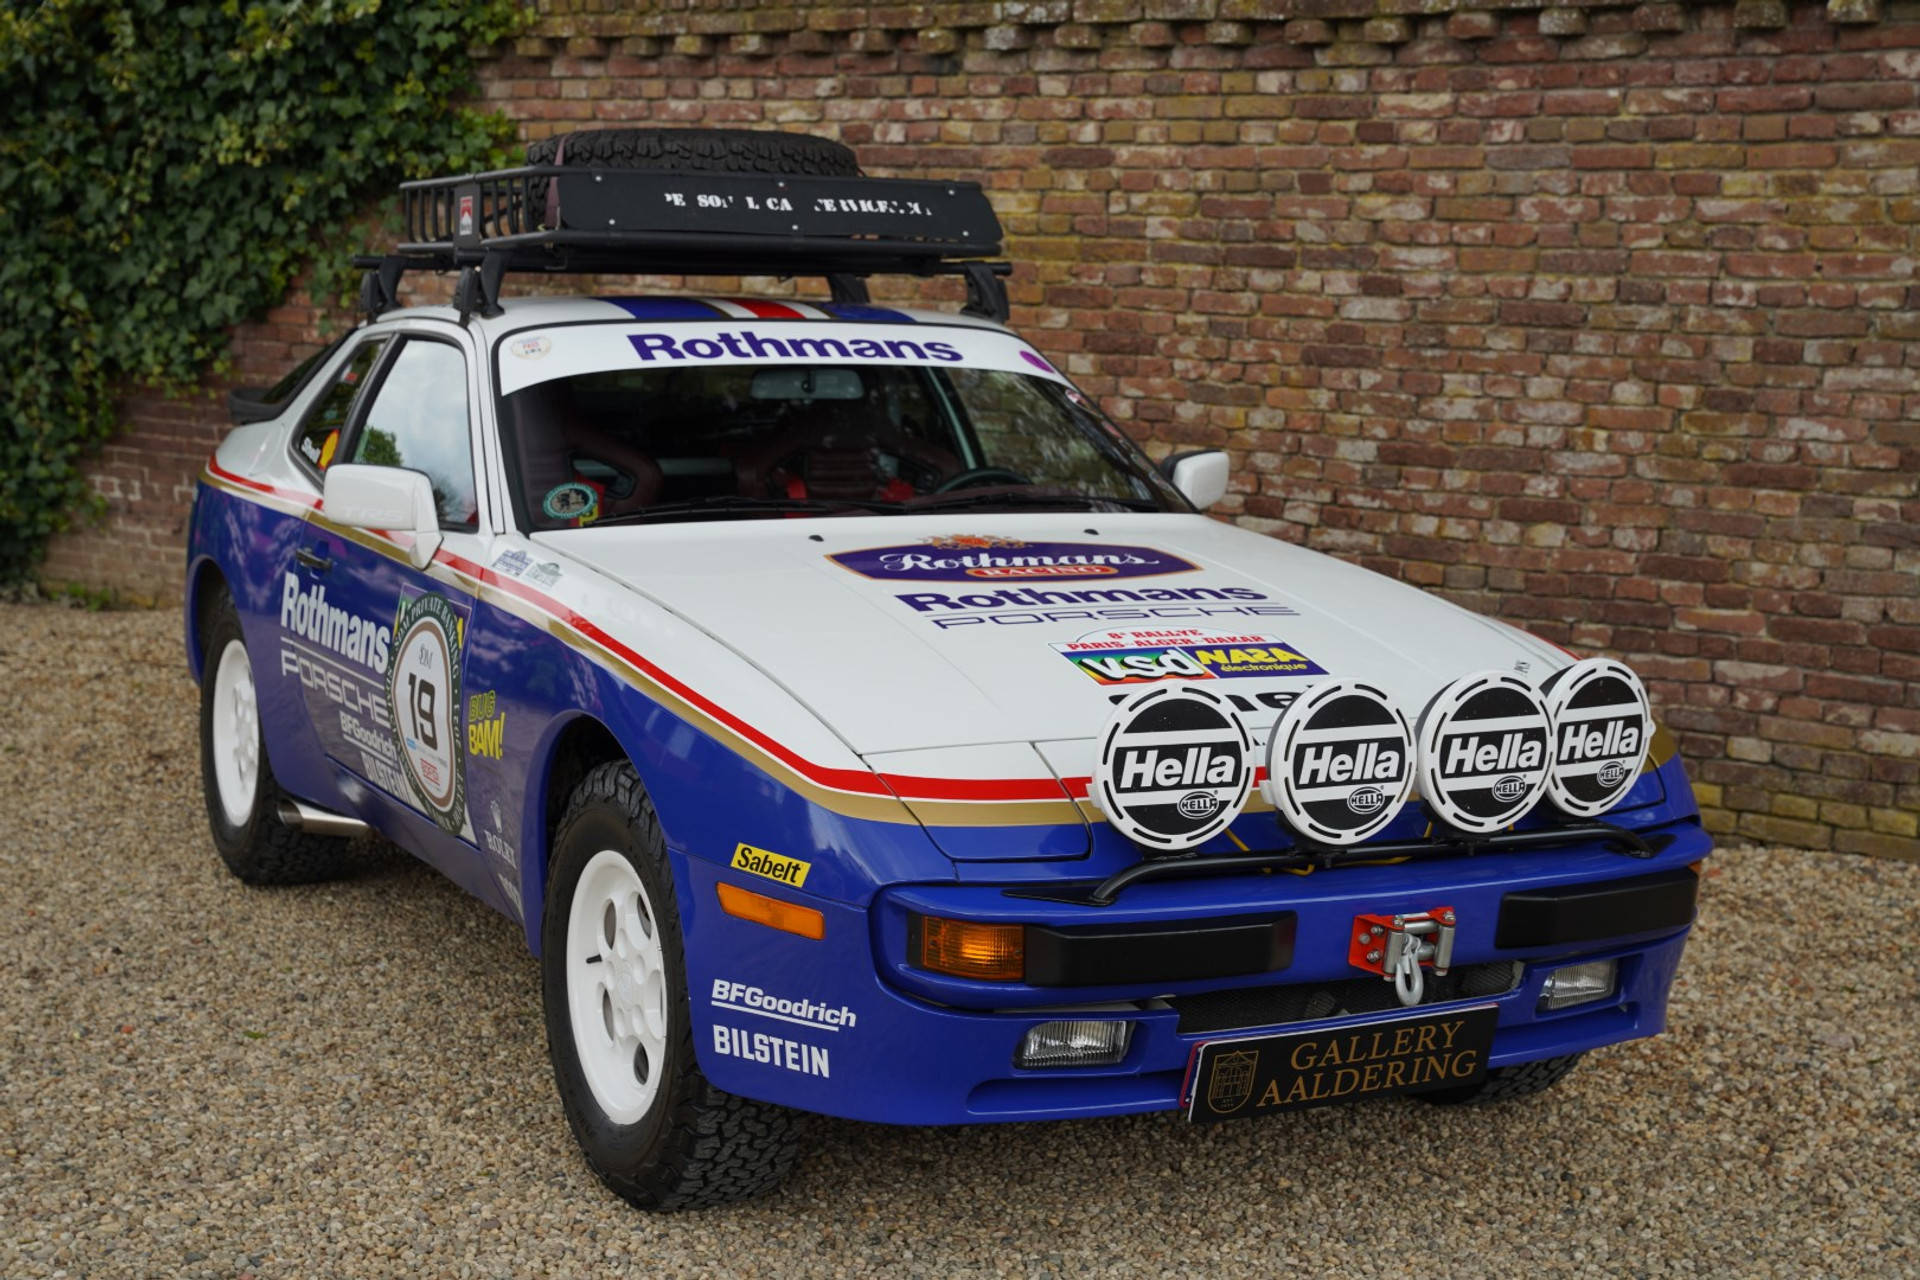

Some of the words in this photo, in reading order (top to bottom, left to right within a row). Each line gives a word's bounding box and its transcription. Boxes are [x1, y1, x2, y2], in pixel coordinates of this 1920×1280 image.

[627, 331, 963, 363] Rothmans
[880, 553, 1160, 571] Rothmans
[983, 567, 1101, 576] RACING
[894, 586, 1268, 612] Rothmans
[932, 606, 1301, 629] PORSCHE
[281, 572, 391, 675] Rothmans
[411, 597, 442, 619] PRIVATE
[441, 606, 460, 679] BANKING
[1129, 629, 1203, 639] RALLYE
[1221, 661, 1308, 674] électronique
[281, 650, 391, 729] PORSCHE
[469, 690, 496, 722] BUG
[408, 672, 439, 751] 19
[340, 712, 397, 761] BFGoodrich
[469, 712, 505, 760] BAM!
[1444, 731, 1540, 775] Hella
[1558, 720, 1640, 762] Hella
[1120, 745, 1236, 788] Hella
[1300, 740, 1400, 784] Hella
[1599, 767, 1624, 782] HELLA
[1181, 796, 1217, 813] HELLA
[1350, 791, 1384, 808] HELLA
[1495, 779, 1525, 796] HELLA
[737, 847, 802, 884] Sabelt
[712, 979, 857, 1027] BFGoodrich
[713, 1024, 830, 1078] BILSTEIN
[1291, 1021, 1465, 1071] GALLERY
[1256, 1050, 1477, 1107] AALDERING
